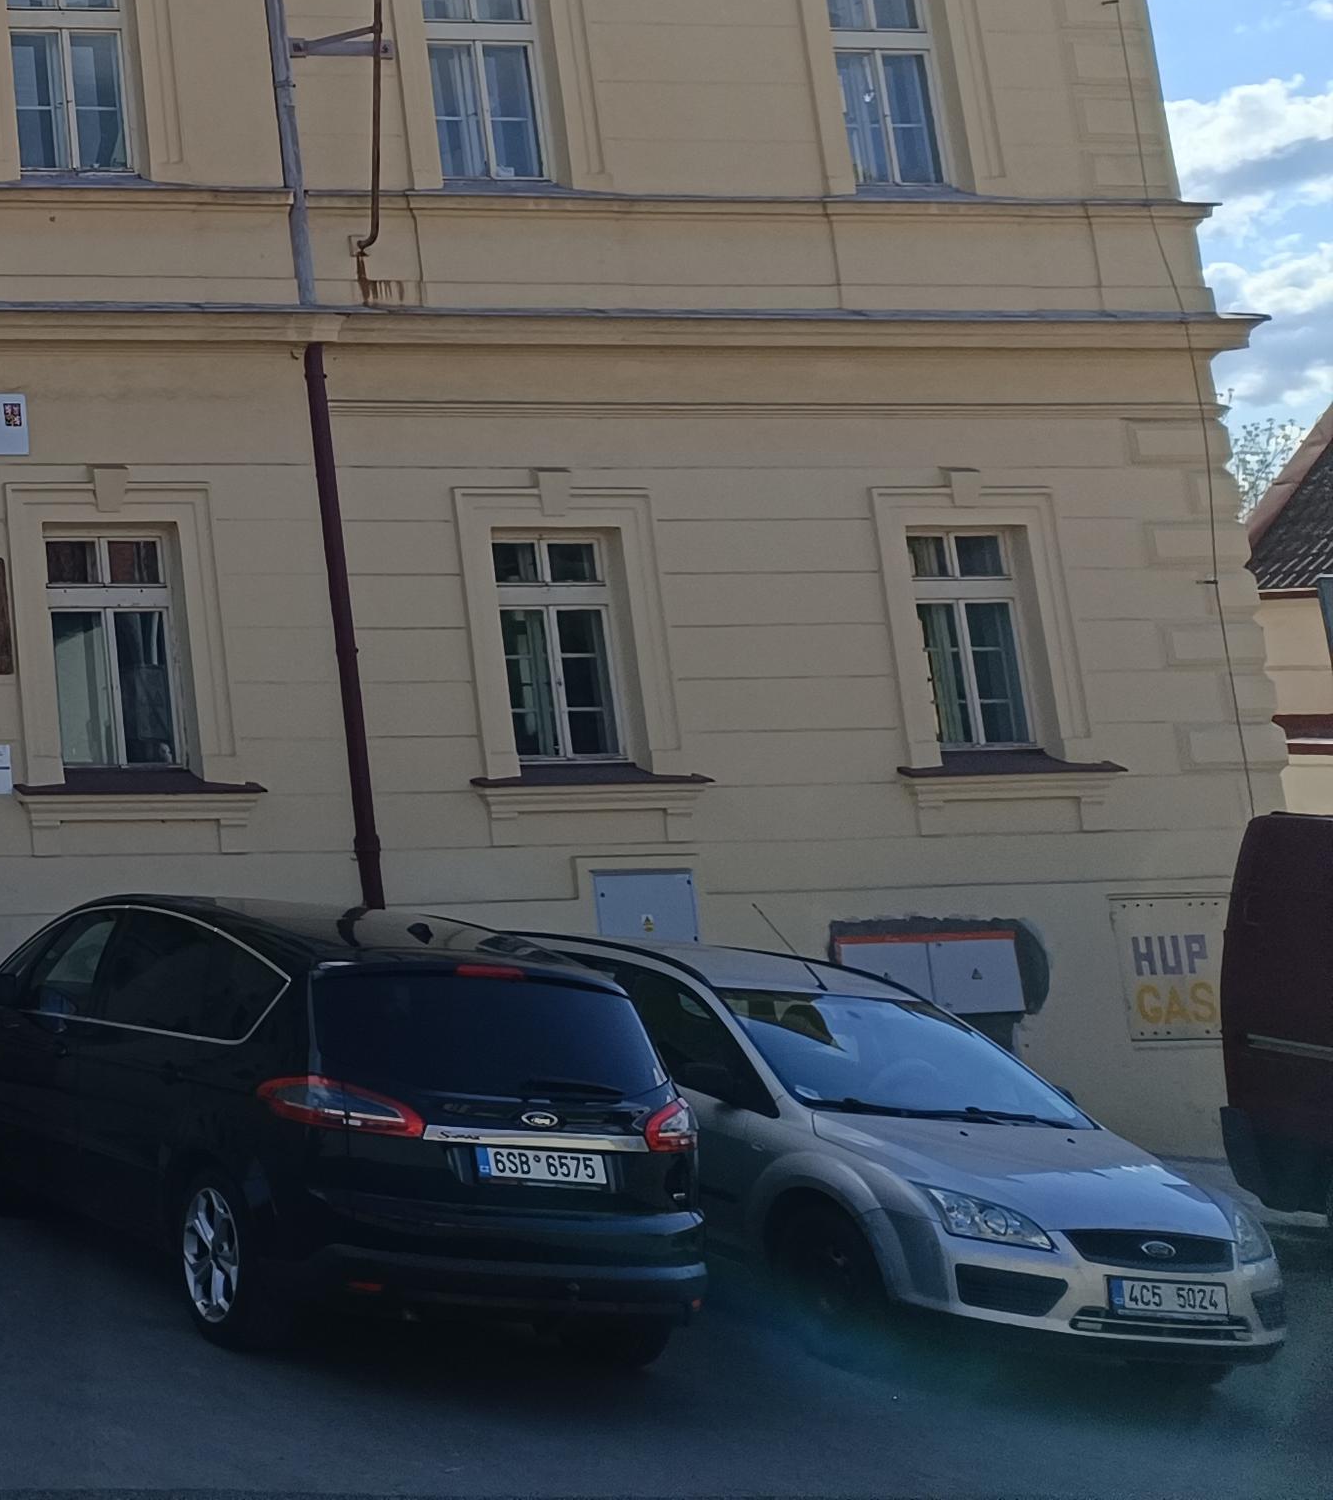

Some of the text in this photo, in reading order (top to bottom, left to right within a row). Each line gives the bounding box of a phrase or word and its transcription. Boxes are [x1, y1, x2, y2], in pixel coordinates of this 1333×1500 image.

[1131, 934, 1208, 976] HUP
[1136, 981, 1217, 1025] GAS
[493, 1151, 595, 1179] 6SB 6575
[1129, 1284, 1218, 1310] 4C5 5024
